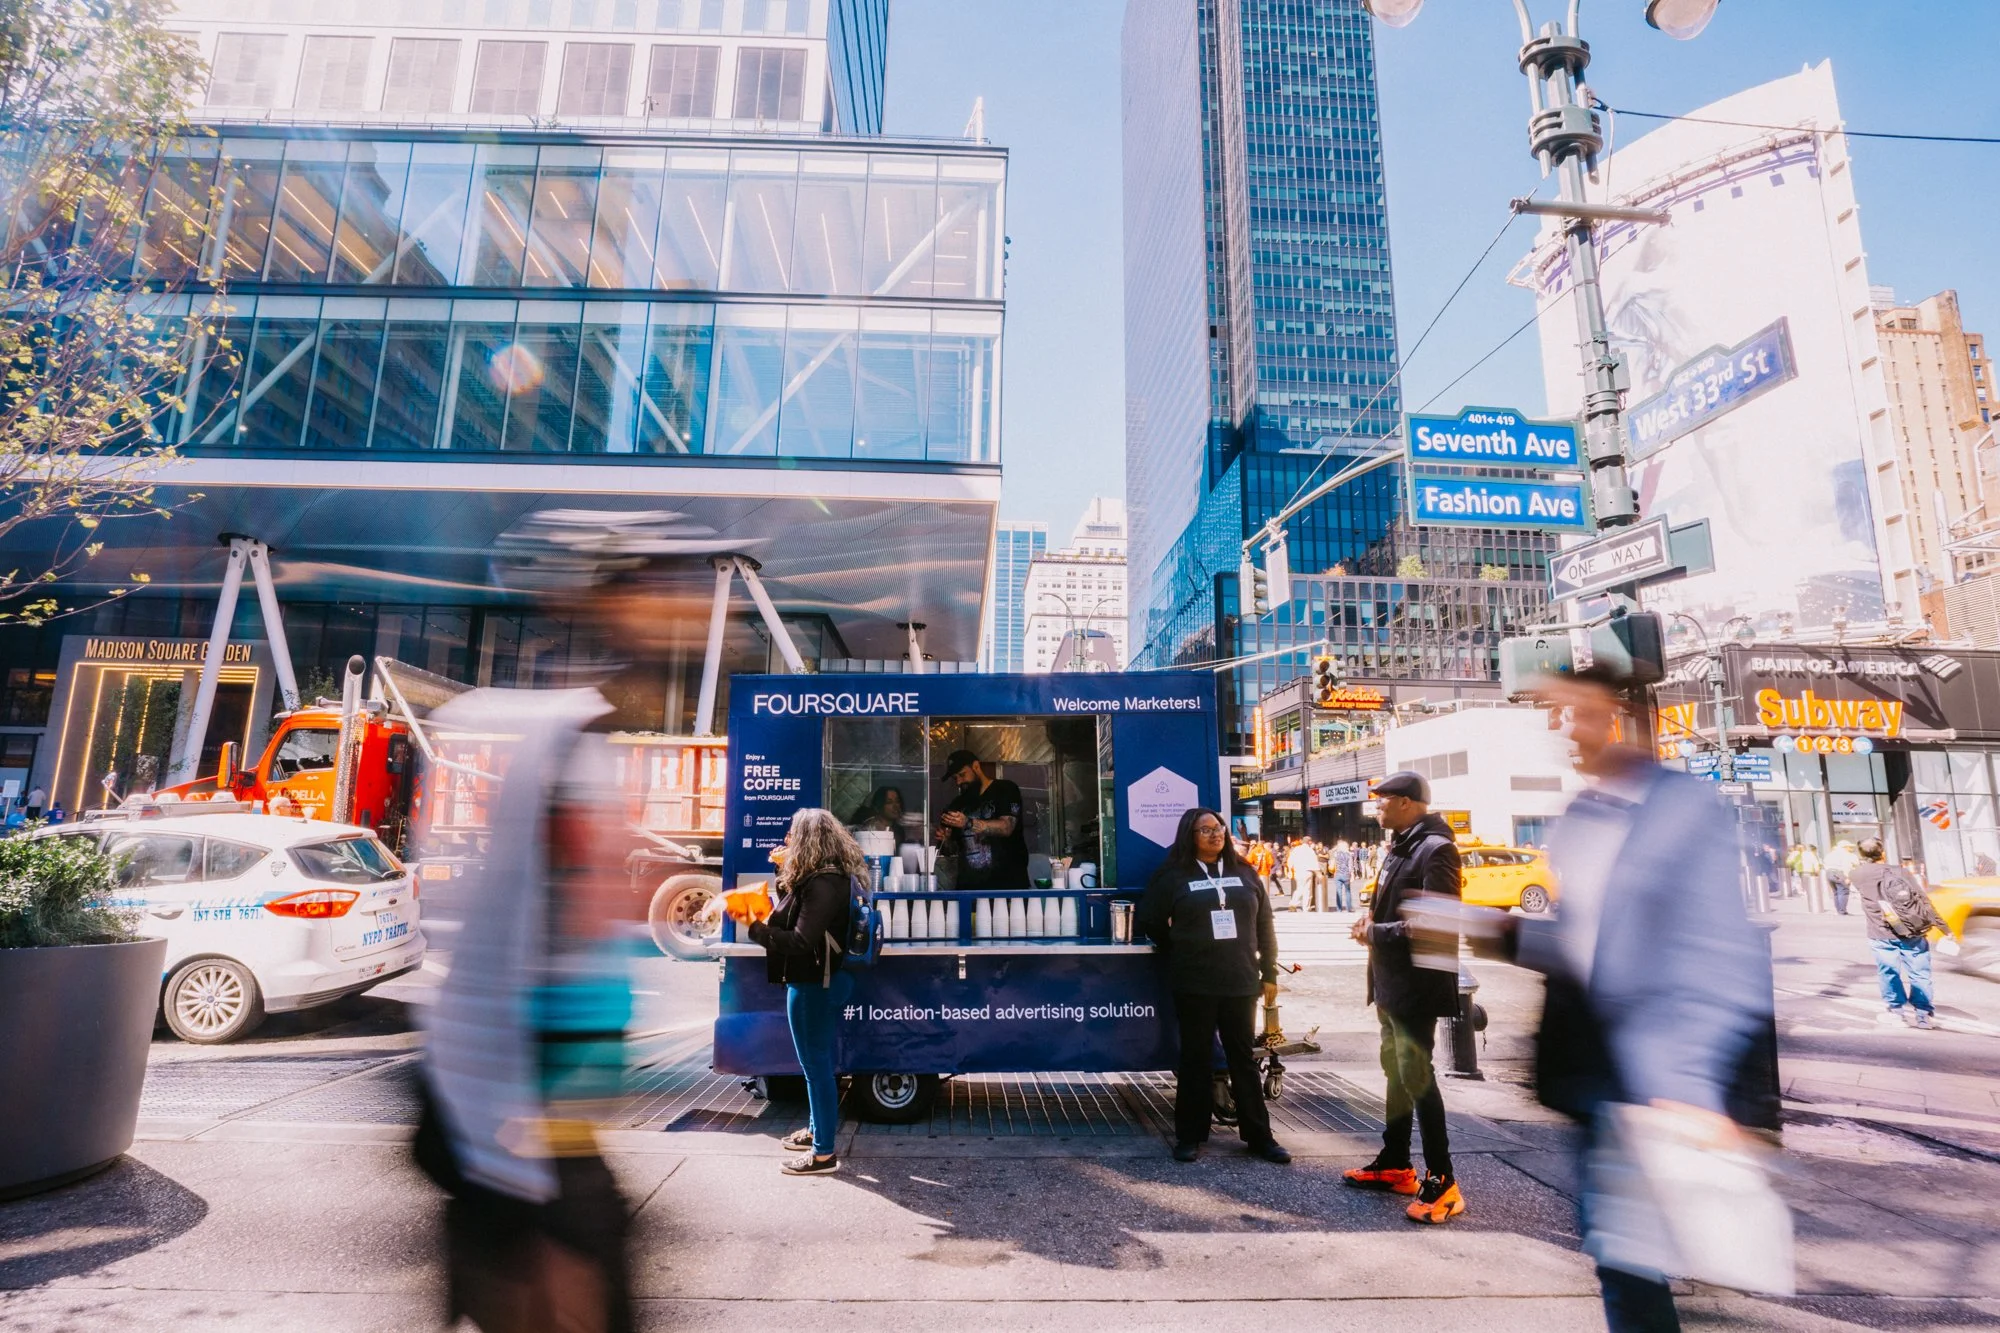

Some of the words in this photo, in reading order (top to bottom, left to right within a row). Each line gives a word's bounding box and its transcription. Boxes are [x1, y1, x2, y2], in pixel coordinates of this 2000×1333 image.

[1635, 393, 1689, 441] West
[1691, 361, 1734, 411] 33rd
[1741, 348, 1770, 384] St
[1468, 413, 1487, 424] 401
[1496, 415, 1515, 425] 419
[1416, 426, 1517, 455] Seventh
[1524, 432, 1570, 458] Ave
[1425, 486, 1521, 515] Fashion
[1528, 492, 1575, 518] Ave
[1568, 558, 1597, 580] ONE
[1610, 541, 1645, 566] WAY
[85, 638, 145, 659] MADISON
[148, 639, 198, 660] SQUARE
[201, 641, 252, 662] GDEN
[1751, 657, 1805, 673] BANK
[1806, 659, 1836, 674] OF
[1835, 661, 1921, 676] AMERICA
[753, 692, 920, 715] FOURSQUARE
[1053, 697, 1121, 711] Welcome
[1124, 696, 1201, 710] Marketers!
[1755, 688, 1903, 737] Subway
[1800, 739, 1809, 748] 1
[1819, 738, 1830, 748] 2
[1839, 738, 1850, 748] 3
[744, 765, 781, 777] FREE
[743, 778, 801, 790] COFFEE
[1325, 788, 1335, 798] LOS
[1335, 786, 1349, 796] TACOS
[1349, 784, 1360, 794] No.1
[193, 908, 209, 922] INT
[213, 908, 231, 921] STH
[239, 908, 259, 921] 7671
[362, 929, 383, 947] NYPD
[385, 922, 409, 941] TRAFFIC
[843, 1004, 863, 1021] #1
[869, 1003, 990, 1021] location-based
[995, 1003, 1084, 1023] advertising
[1089, 1002, 1155, 1019] solution
